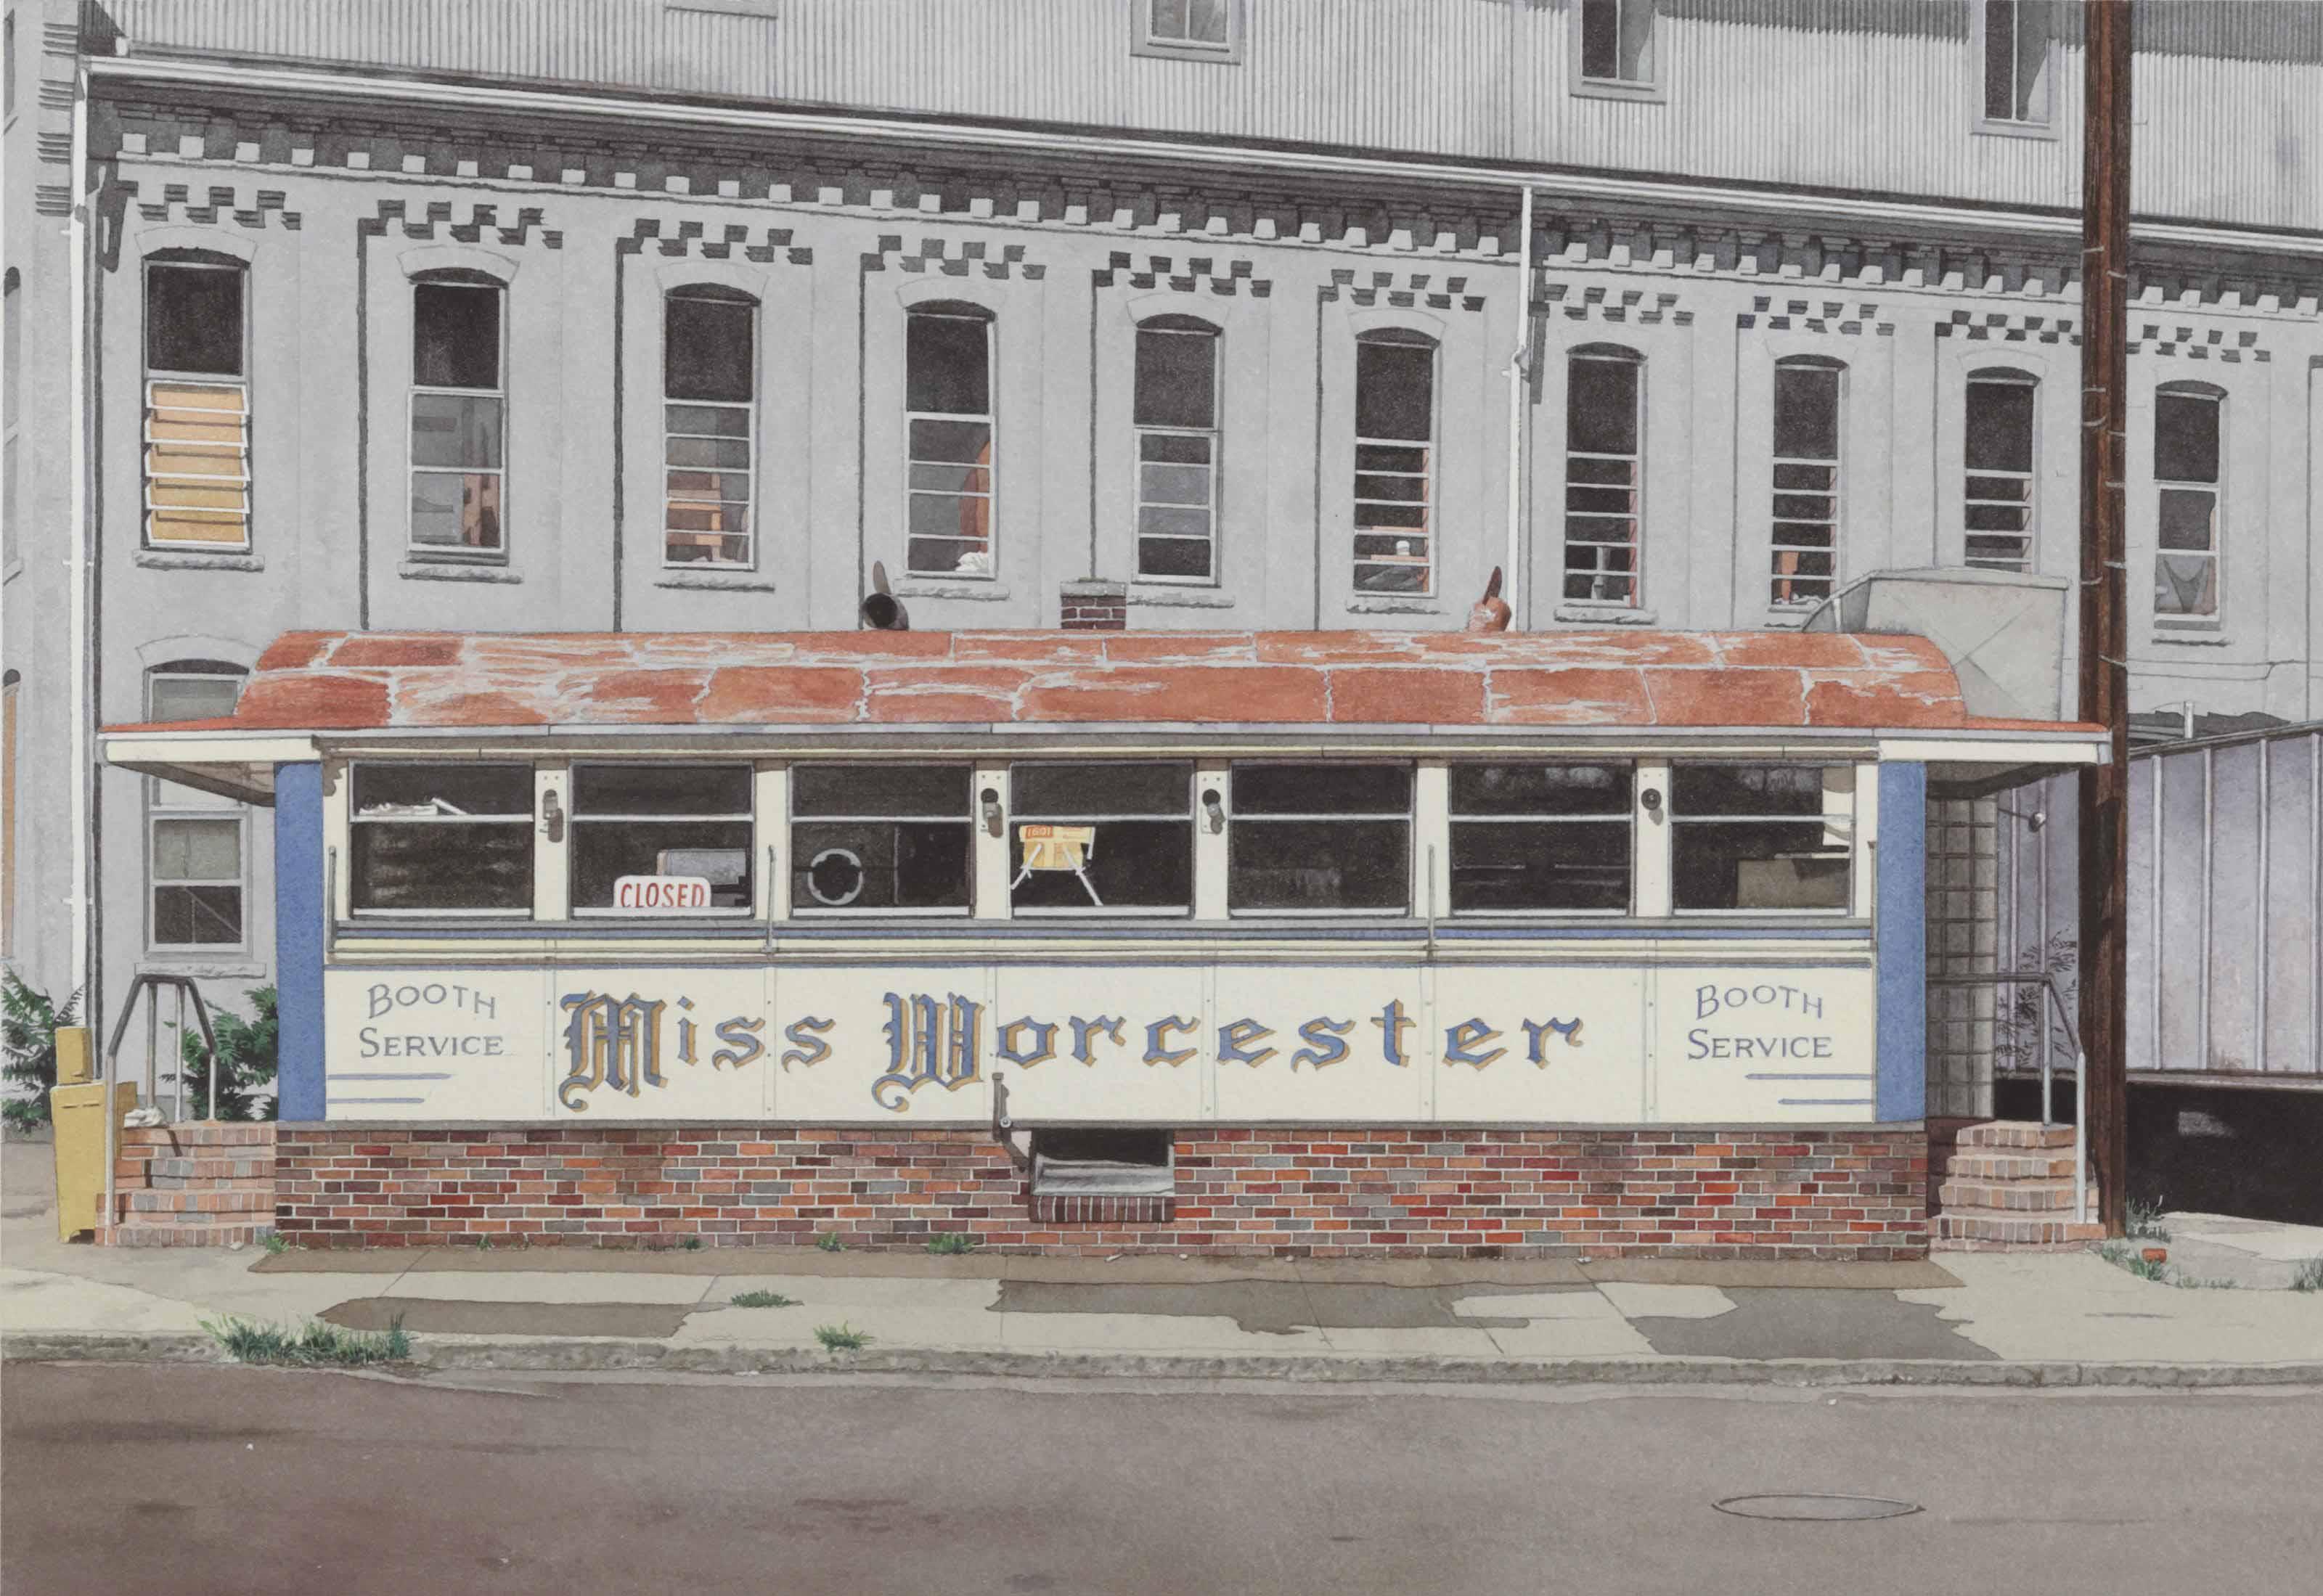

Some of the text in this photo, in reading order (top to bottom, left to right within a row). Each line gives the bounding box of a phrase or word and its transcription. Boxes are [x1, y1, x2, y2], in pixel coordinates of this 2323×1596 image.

[621, 883, 705, 908] CLOSED
[367, 983, 496, 1020] BOOTH
[1695, 984, 1823, 1020] BOOTH
[359, 1026, 505, 1058] SERVICE
[558, 989, 1584, 1113] Miss Worcester
[1687, 1028, 1833, 1060] SERVICE
